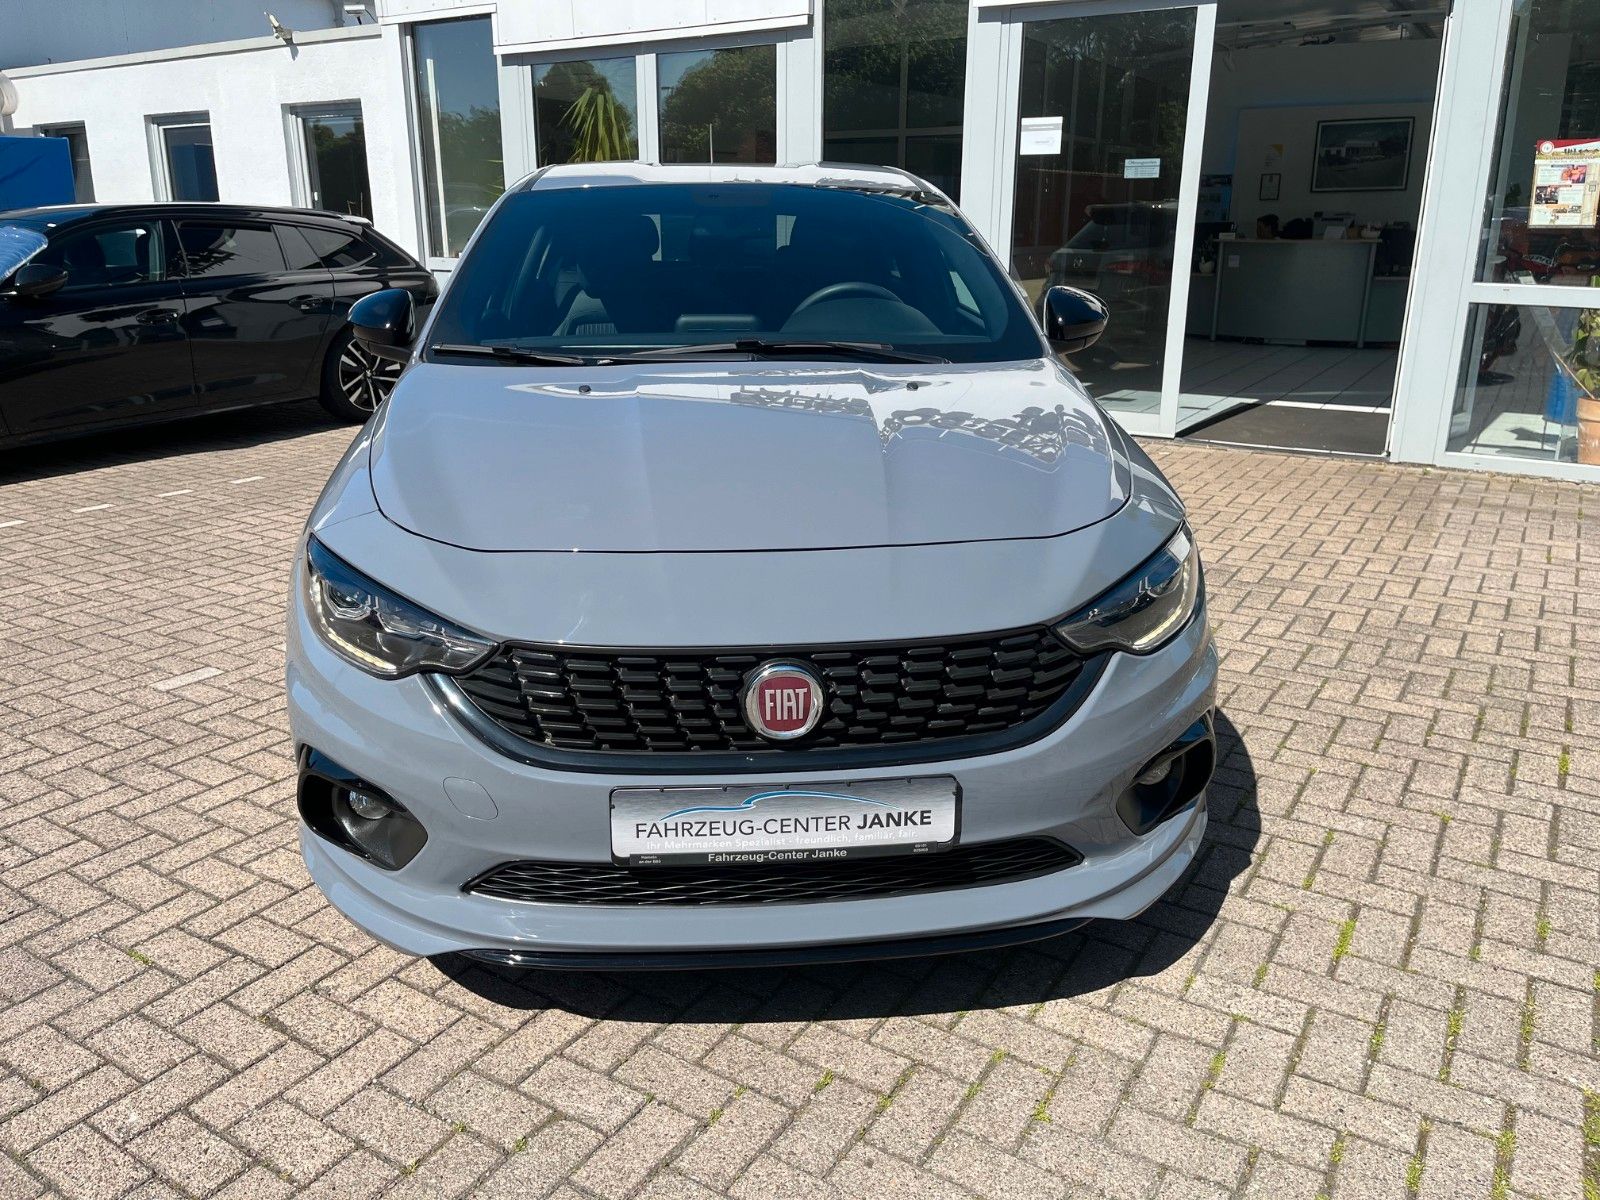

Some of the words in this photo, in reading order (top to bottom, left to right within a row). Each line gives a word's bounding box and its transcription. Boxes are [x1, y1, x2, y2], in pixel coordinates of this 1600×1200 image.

[764, 687, 808, 721] FIAT
[635, 815, 851, 838] FAHRZEUG-CENTER
[856, 809, 932, 830] JANKE
[664, 840, 732, 850] Mehrmarken
[735, 836, 785, 849] Spezialist
[796, 833, 851, 846] freundlich,
[898, 829, 919, 839] fair.
[708, 850, 809, 863] Fahrzeug-Center
[811, 849, 848, 859] Janke
